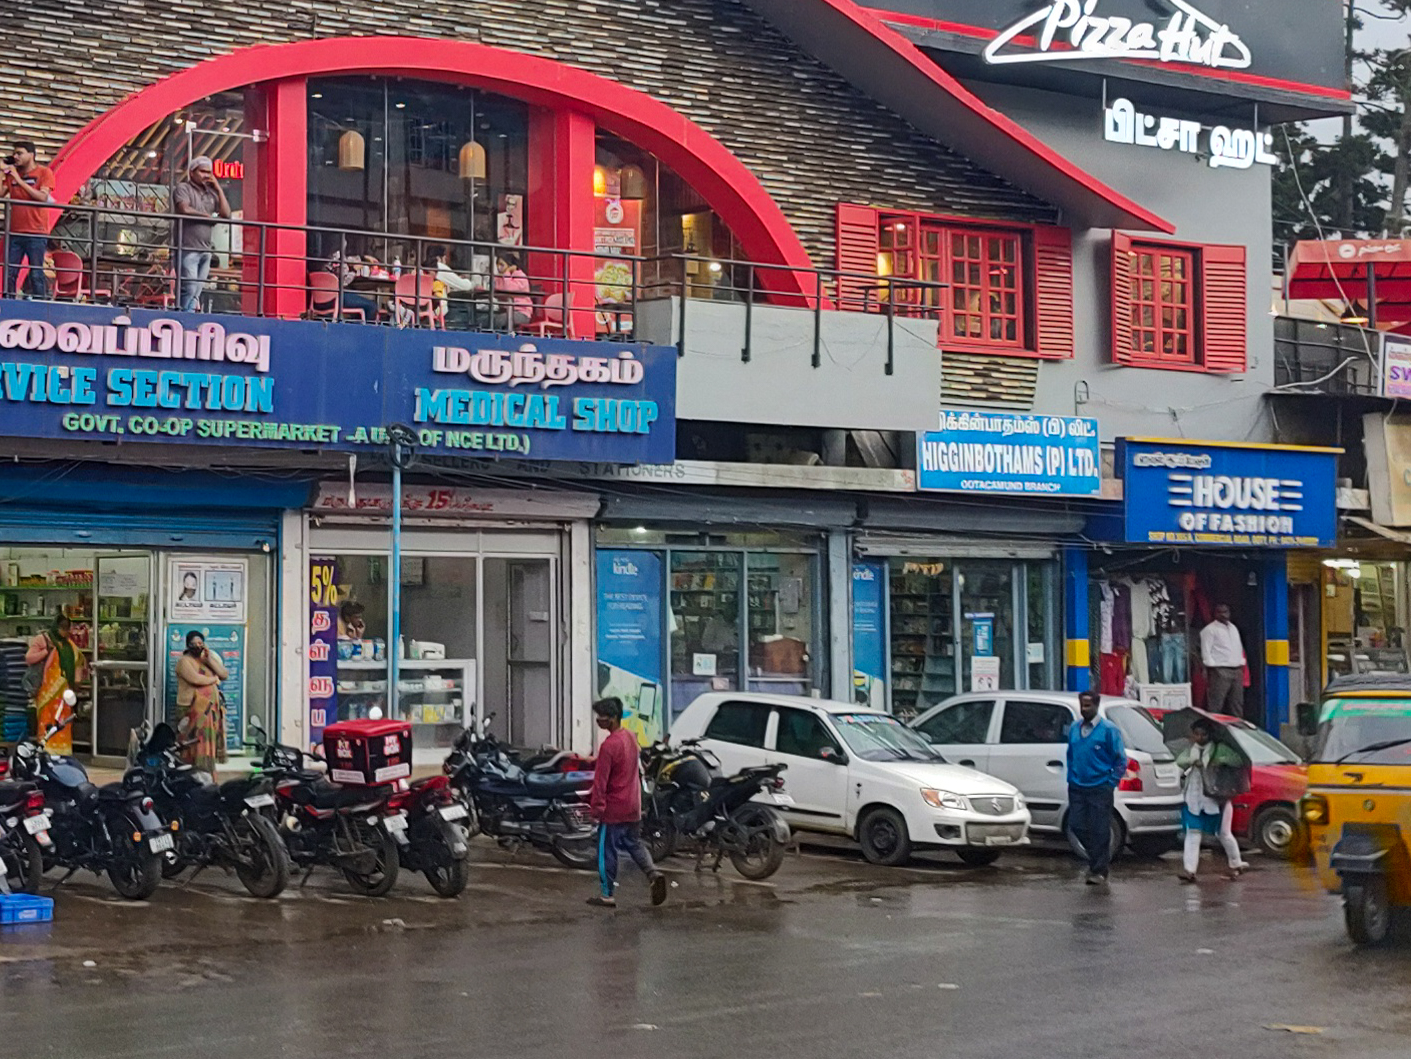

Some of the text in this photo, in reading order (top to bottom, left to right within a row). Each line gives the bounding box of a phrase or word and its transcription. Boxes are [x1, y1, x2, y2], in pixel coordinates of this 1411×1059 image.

[1156, 10, 1240, 66] Hut
[1105, 97, 1276, 169] பிட்சா ஹட்
[433, 343, 644, 389] மருந்தகம்
[106, 367, 275, 413] SECTION
[414, 387, 659, 435] MEDICAL SHOP
[62, 412, 125, 435] GOVT.
[128, 415, 194, 437] CO-OP
[197, 418, 341, 443] SUPERMARKET
[420, 429, 443, 447] OF
[446, 431, 484, 449] NCE
[922, 441, 1043, 475] HIGGINBOTHAMS
[1046, 445, 1065, 476] (P)
[1068, 447, 1099, 478] LTD.
[1193, 475, 1280, 511] HOUSE
[1179, 512, 1293, 534] OF FASHION
[311, 565, 338, 607] 5%
